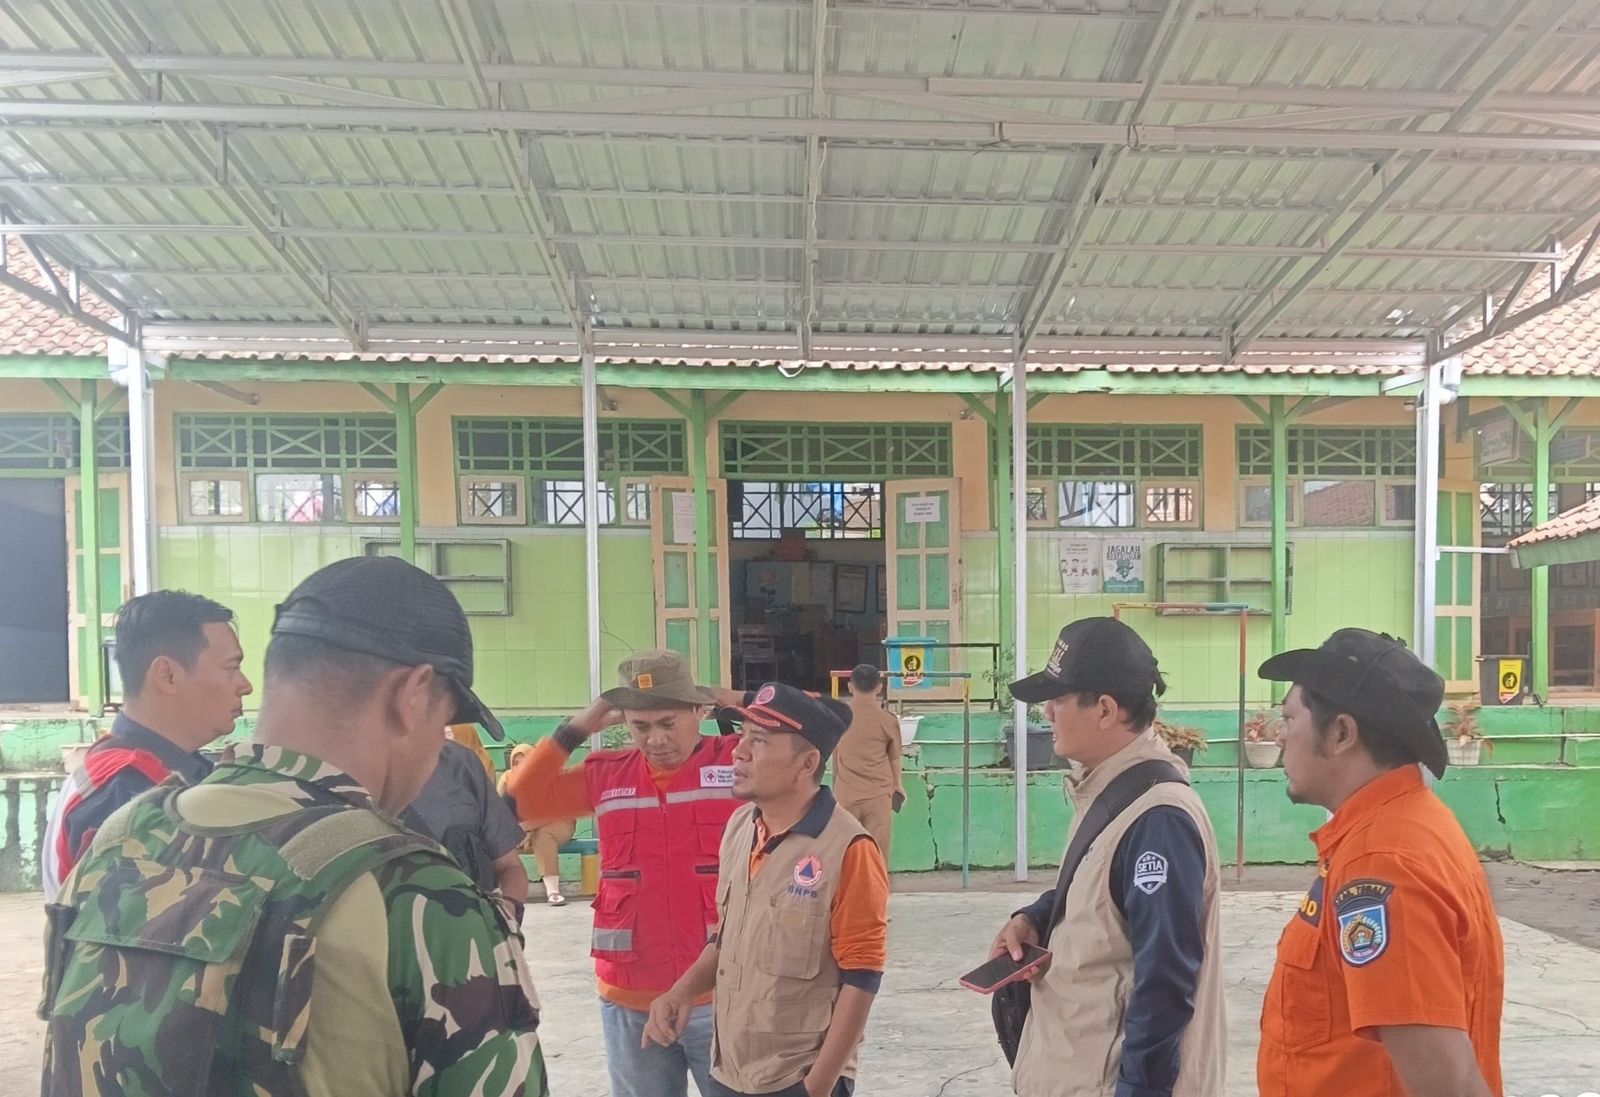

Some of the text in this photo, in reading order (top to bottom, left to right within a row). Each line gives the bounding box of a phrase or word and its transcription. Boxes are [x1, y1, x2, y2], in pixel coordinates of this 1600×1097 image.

[1107, 545, 1140, 555] JAGALAH
[1138, 860, 1163, 873] SETIA
[788, 885, 818, 898] BNPB
